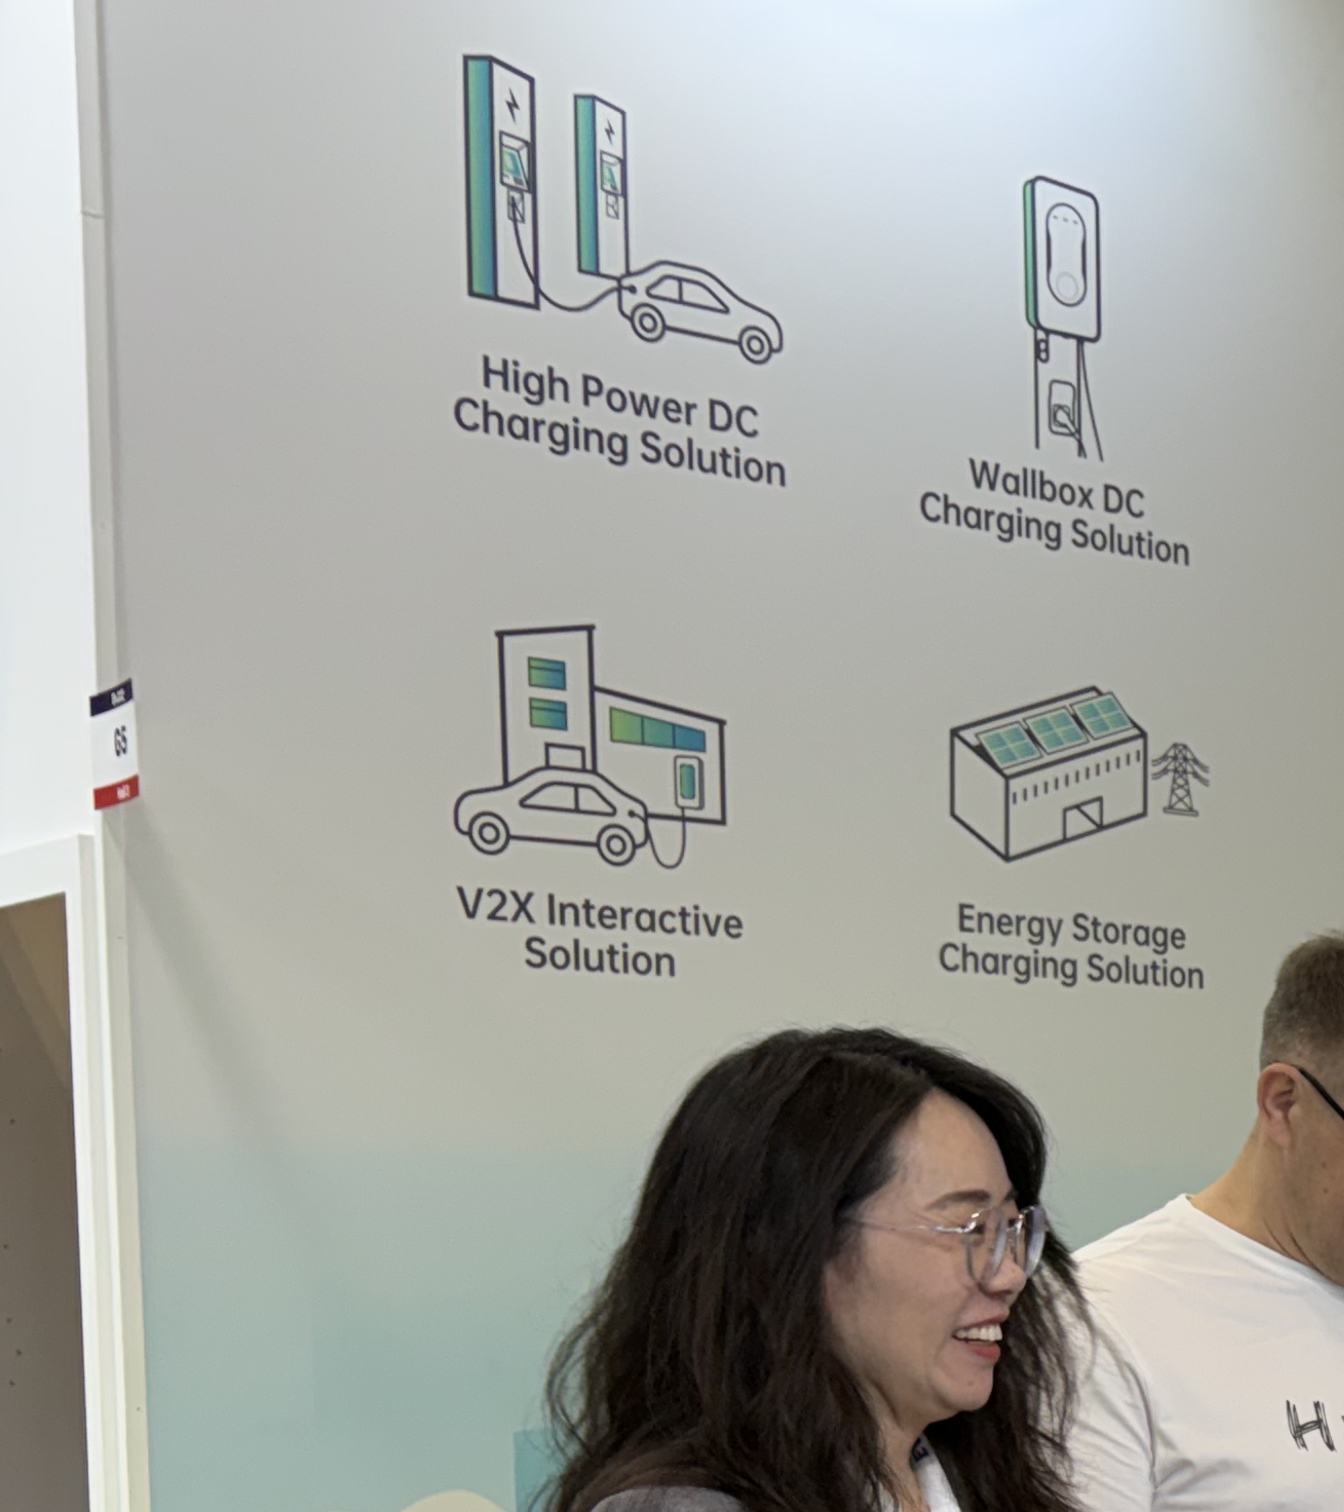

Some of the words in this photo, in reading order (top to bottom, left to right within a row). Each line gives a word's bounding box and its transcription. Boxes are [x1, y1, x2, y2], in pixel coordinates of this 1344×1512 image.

[482, 354, 570, 406] High
[582, 373, 697, 426] Power
[708, 398, 759, 438] DC
[453, 397, 628, 466] Charging
[640, 430, 786, 487] Solution
[969, 457, 1095, 510] Wallbox
[1103, 484, 1144, 518] DC
[920, 491, 1061, 551] Charging
[1072, 518, 1190, 567] Solution
[456, 885, 536, 924] V2X
[548, 893, 743, 939] Interactive
[958, 903, 1063, 947] Energy
[1072, 912, 1186, 955] Storage
[525, 936, 675, 977] Solution
[940, 942, 1078, 987] Charging
[1087, 953, 1204, 990] Solution
